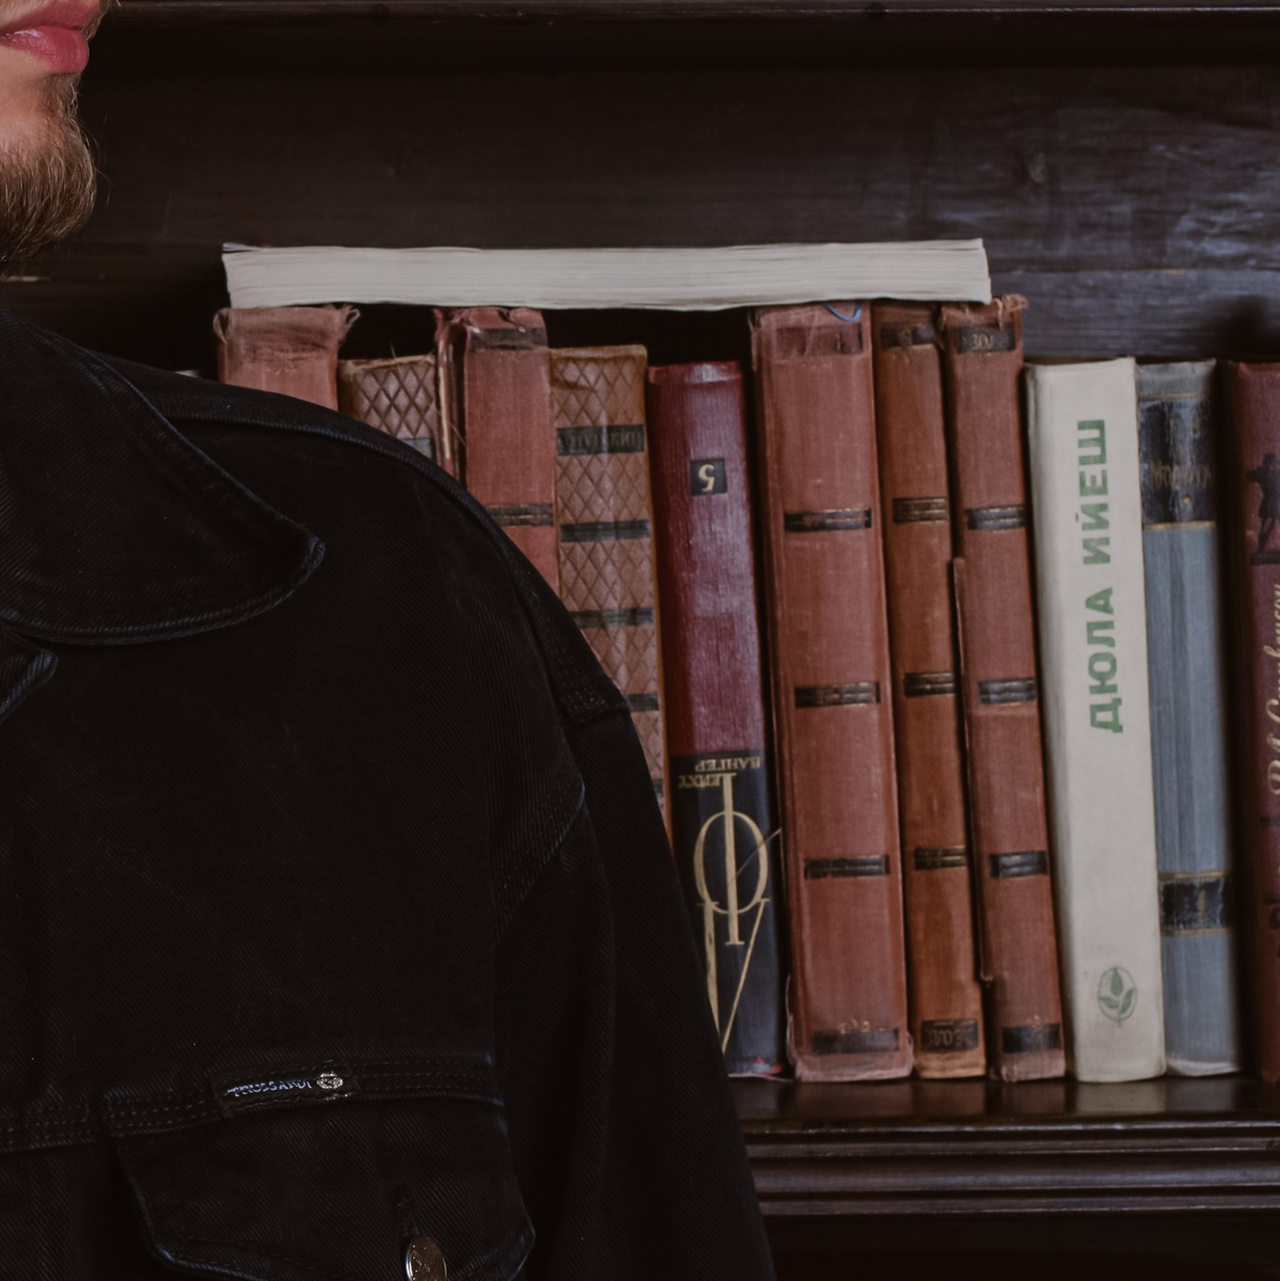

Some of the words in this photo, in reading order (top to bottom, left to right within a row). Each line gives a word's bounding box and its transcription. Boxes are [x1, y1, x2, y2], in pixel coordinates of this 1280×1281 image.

[697, 463, 716, 493] 5
[1075, 418, 1112, 565] ИЙЕШ
[1084, 587, 1124, 734] ДЮЛА
[694, 756, 761, 772] ВАНГЕР
